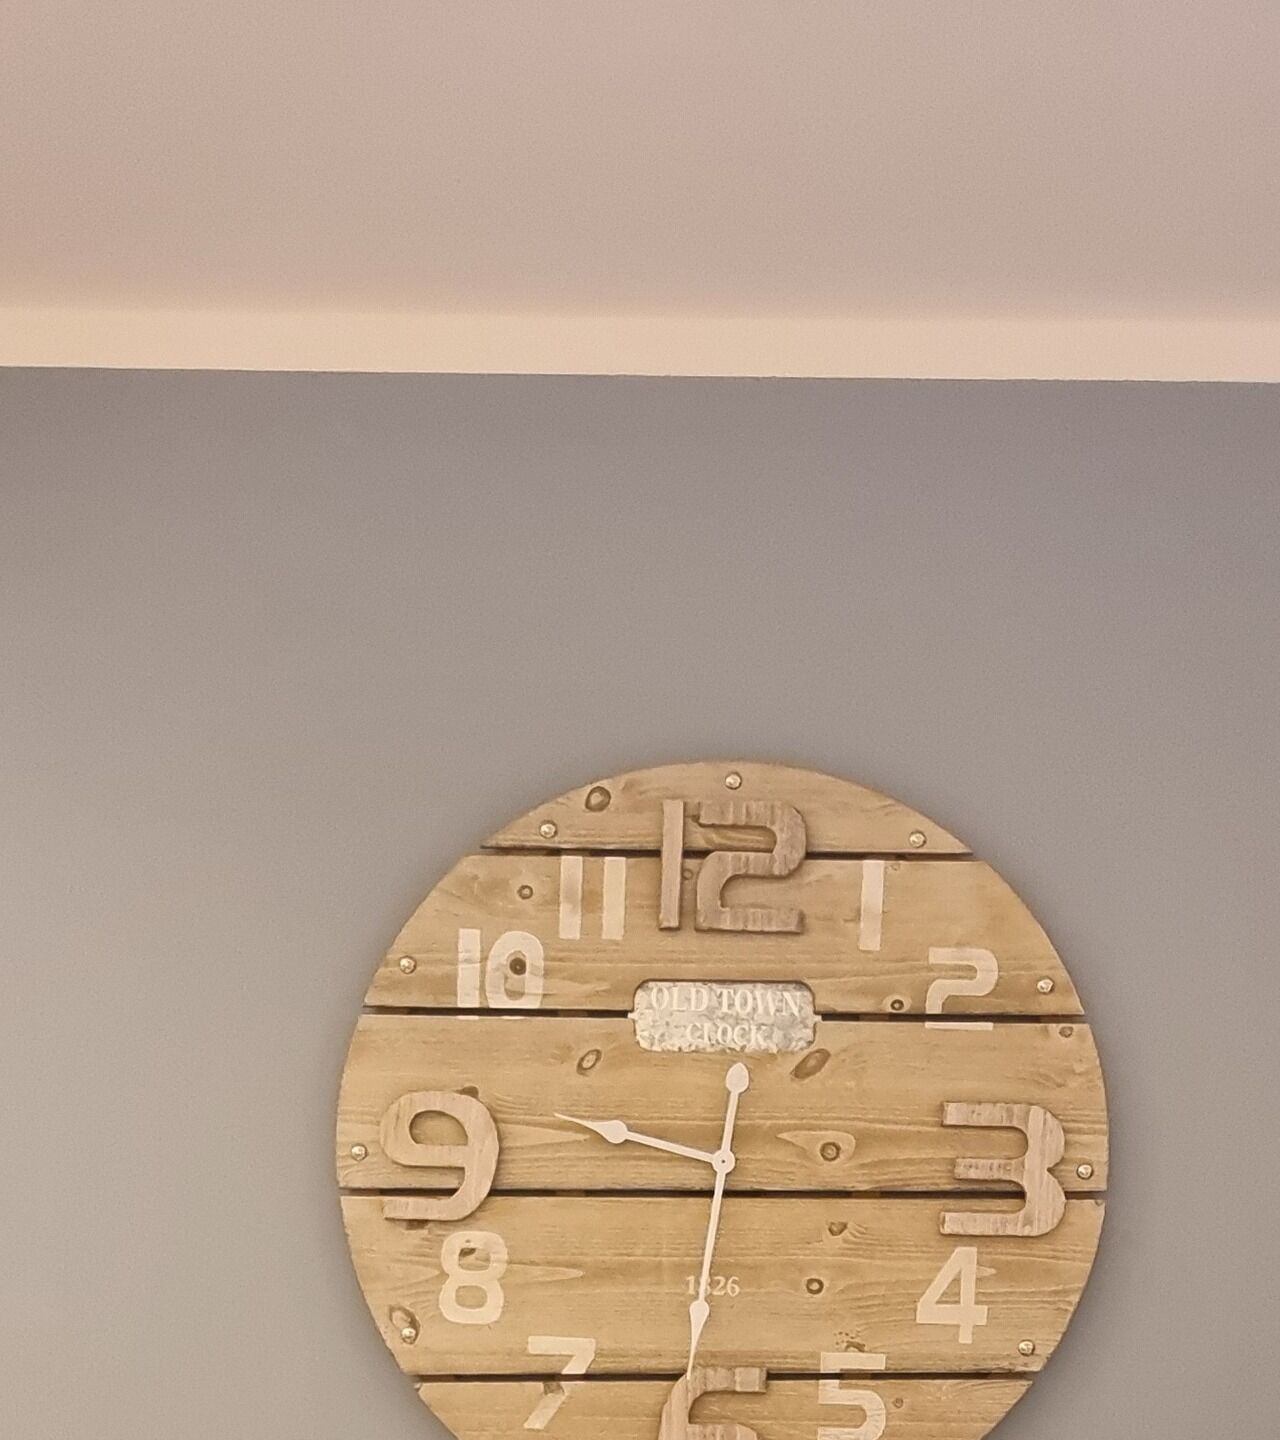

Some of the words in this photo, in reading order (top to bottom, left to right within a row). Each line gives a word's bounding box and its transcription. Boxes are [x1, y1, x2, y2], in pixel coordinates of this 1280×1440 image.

[560, 856, 626, 940] 11
[659, 801, 806, 933] 12
[859, 861, 885, 950] 1
[457, 929, 544, 1020] 10
[651, 986, 710, 1013] OLD
[716, 988, 802, 1018] TOWN
[926, 948, 998, 1030] 2
[686, 1022, 769, 1049] CLOCK
[380, 1091, 500, 1222] 9
[940, 1101, 1067, 1237] 3
[438, 1231, 508, 1325] 8
[916, 1247, 988, 1344] 4
[524, 1336, 596, 1430] 7
